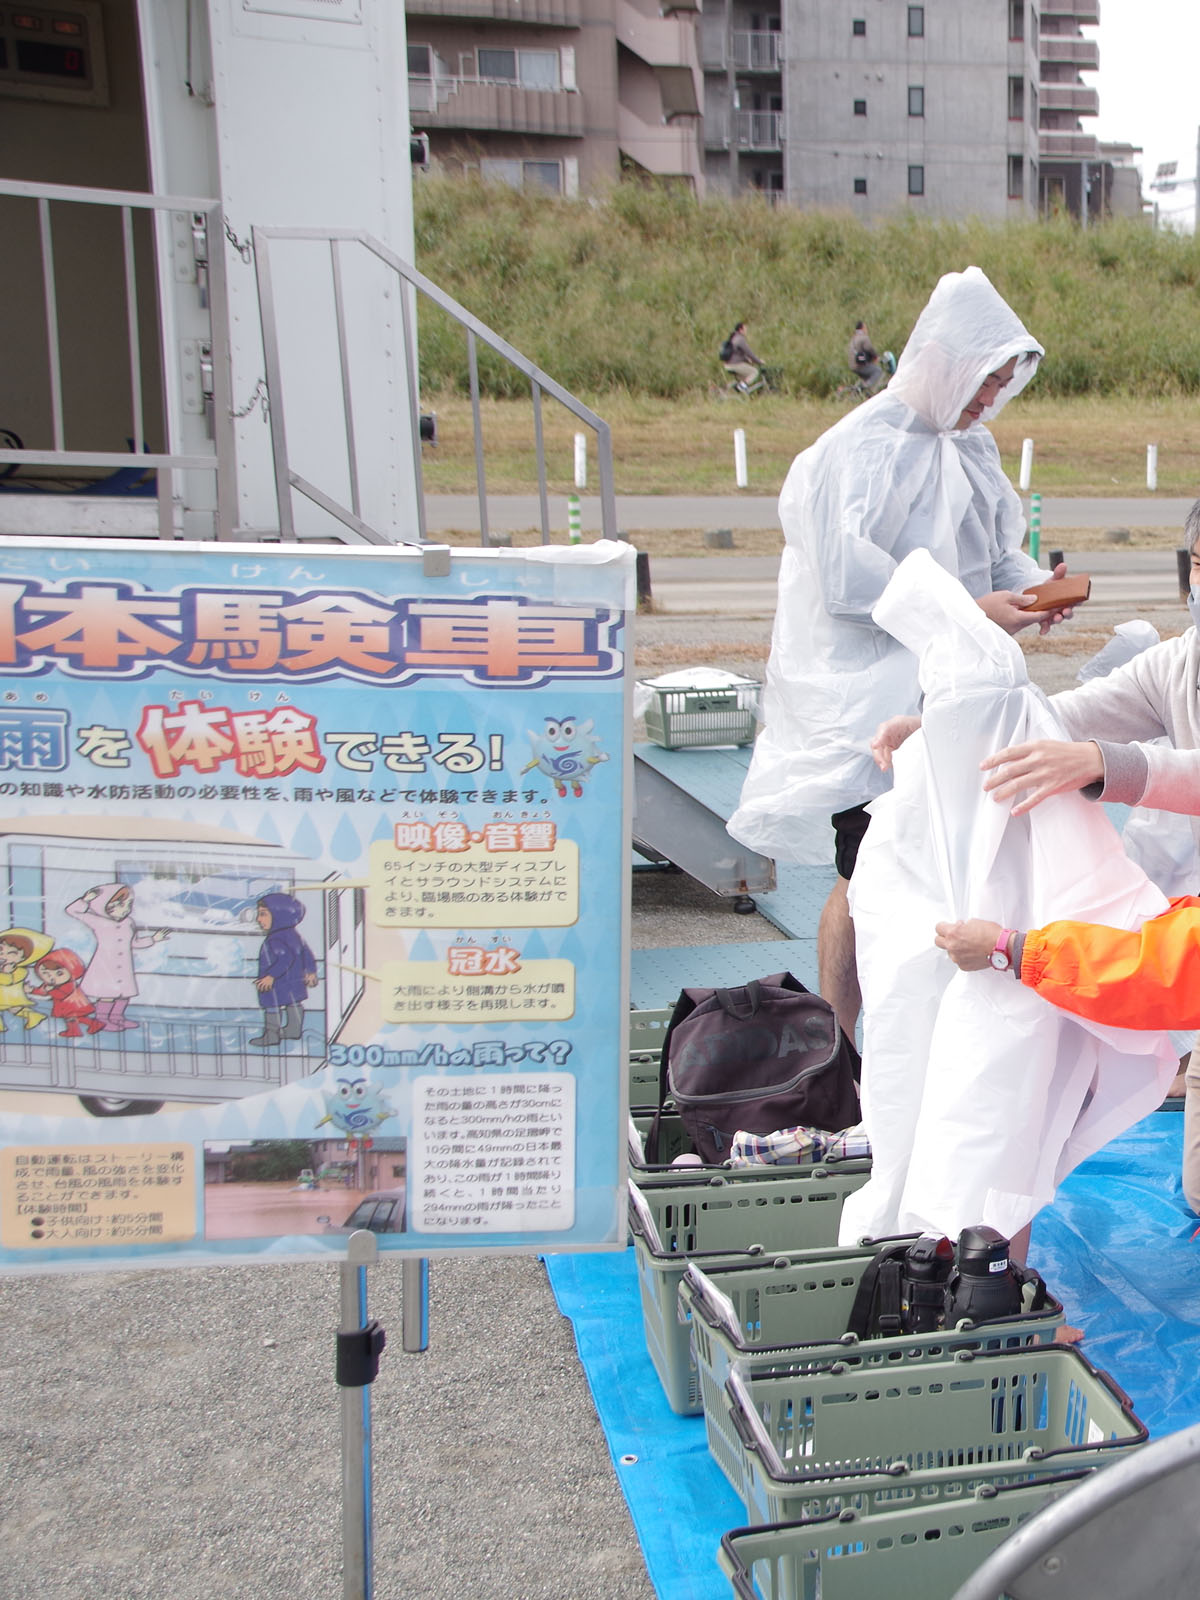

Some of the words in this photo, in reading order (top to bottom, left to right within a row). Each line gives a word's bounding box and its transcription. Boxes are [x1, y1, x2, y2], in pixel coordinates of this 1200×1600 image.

[383, 860, 568, 874] 65インチの大型ディスプレ
[383, 876, 568, 888] イとサラウンドシステムに
[384, 907, 435, 918] きます。
[448, 947, 522, 976] 冠水
[393, 999, 557, 1012] き出す様子を再現します。
